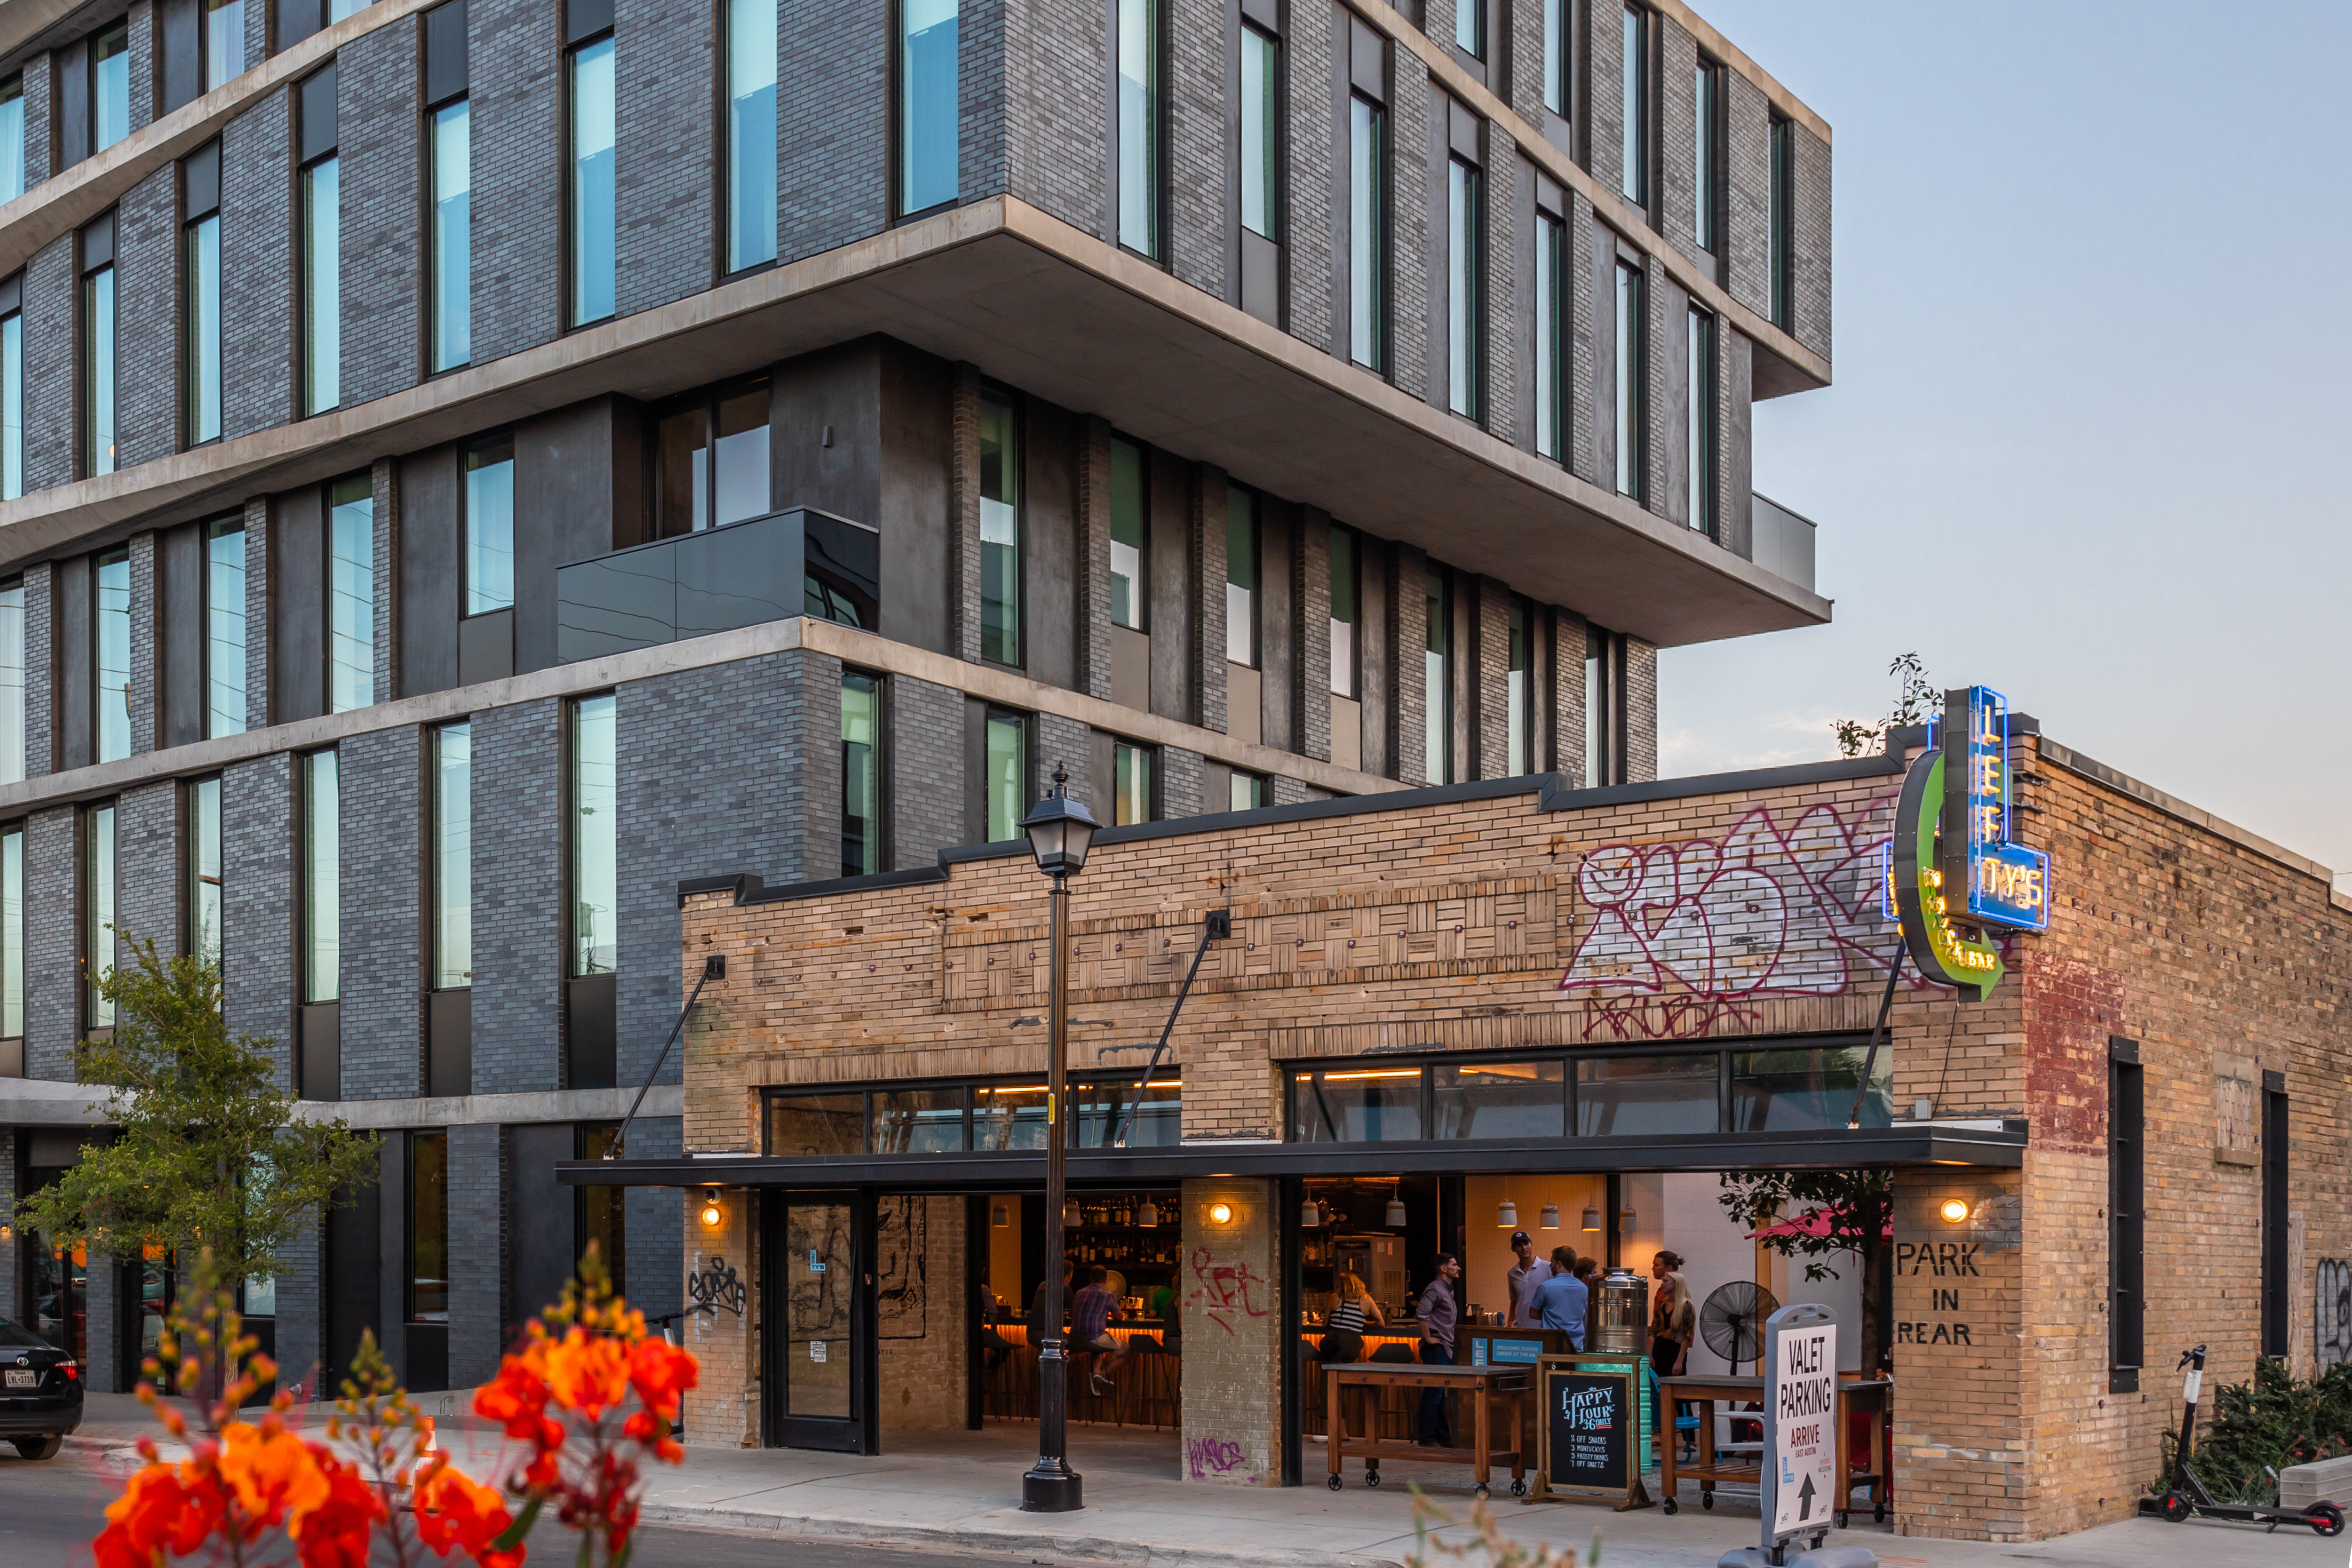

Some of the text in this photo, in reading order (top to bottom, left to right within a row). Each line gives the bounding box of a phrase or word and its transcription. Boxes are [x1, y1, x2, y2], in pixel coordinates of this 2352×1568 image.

[1967, 950, 1995, 971] BAR
[1896, 1242, 1980, 1277] PARK
[1933, 1289, 1958, 1310] IN
[1898, 1322, 1971, 1345] REAR
[1789, 1336, 1825, 1376] VALET
[1562, 1388, 1613, 1410] HAPPY
[1780, 1377, 1831, 1419] PARKING
[1570, 1405, 1611, 1429] HOUR
[1588, 1436, 1606, 1445] SNACKS
[1790, 1424, 1820, 1448] ARRIVE
[1804, 1447, 1816, 1456] AUSTIN
